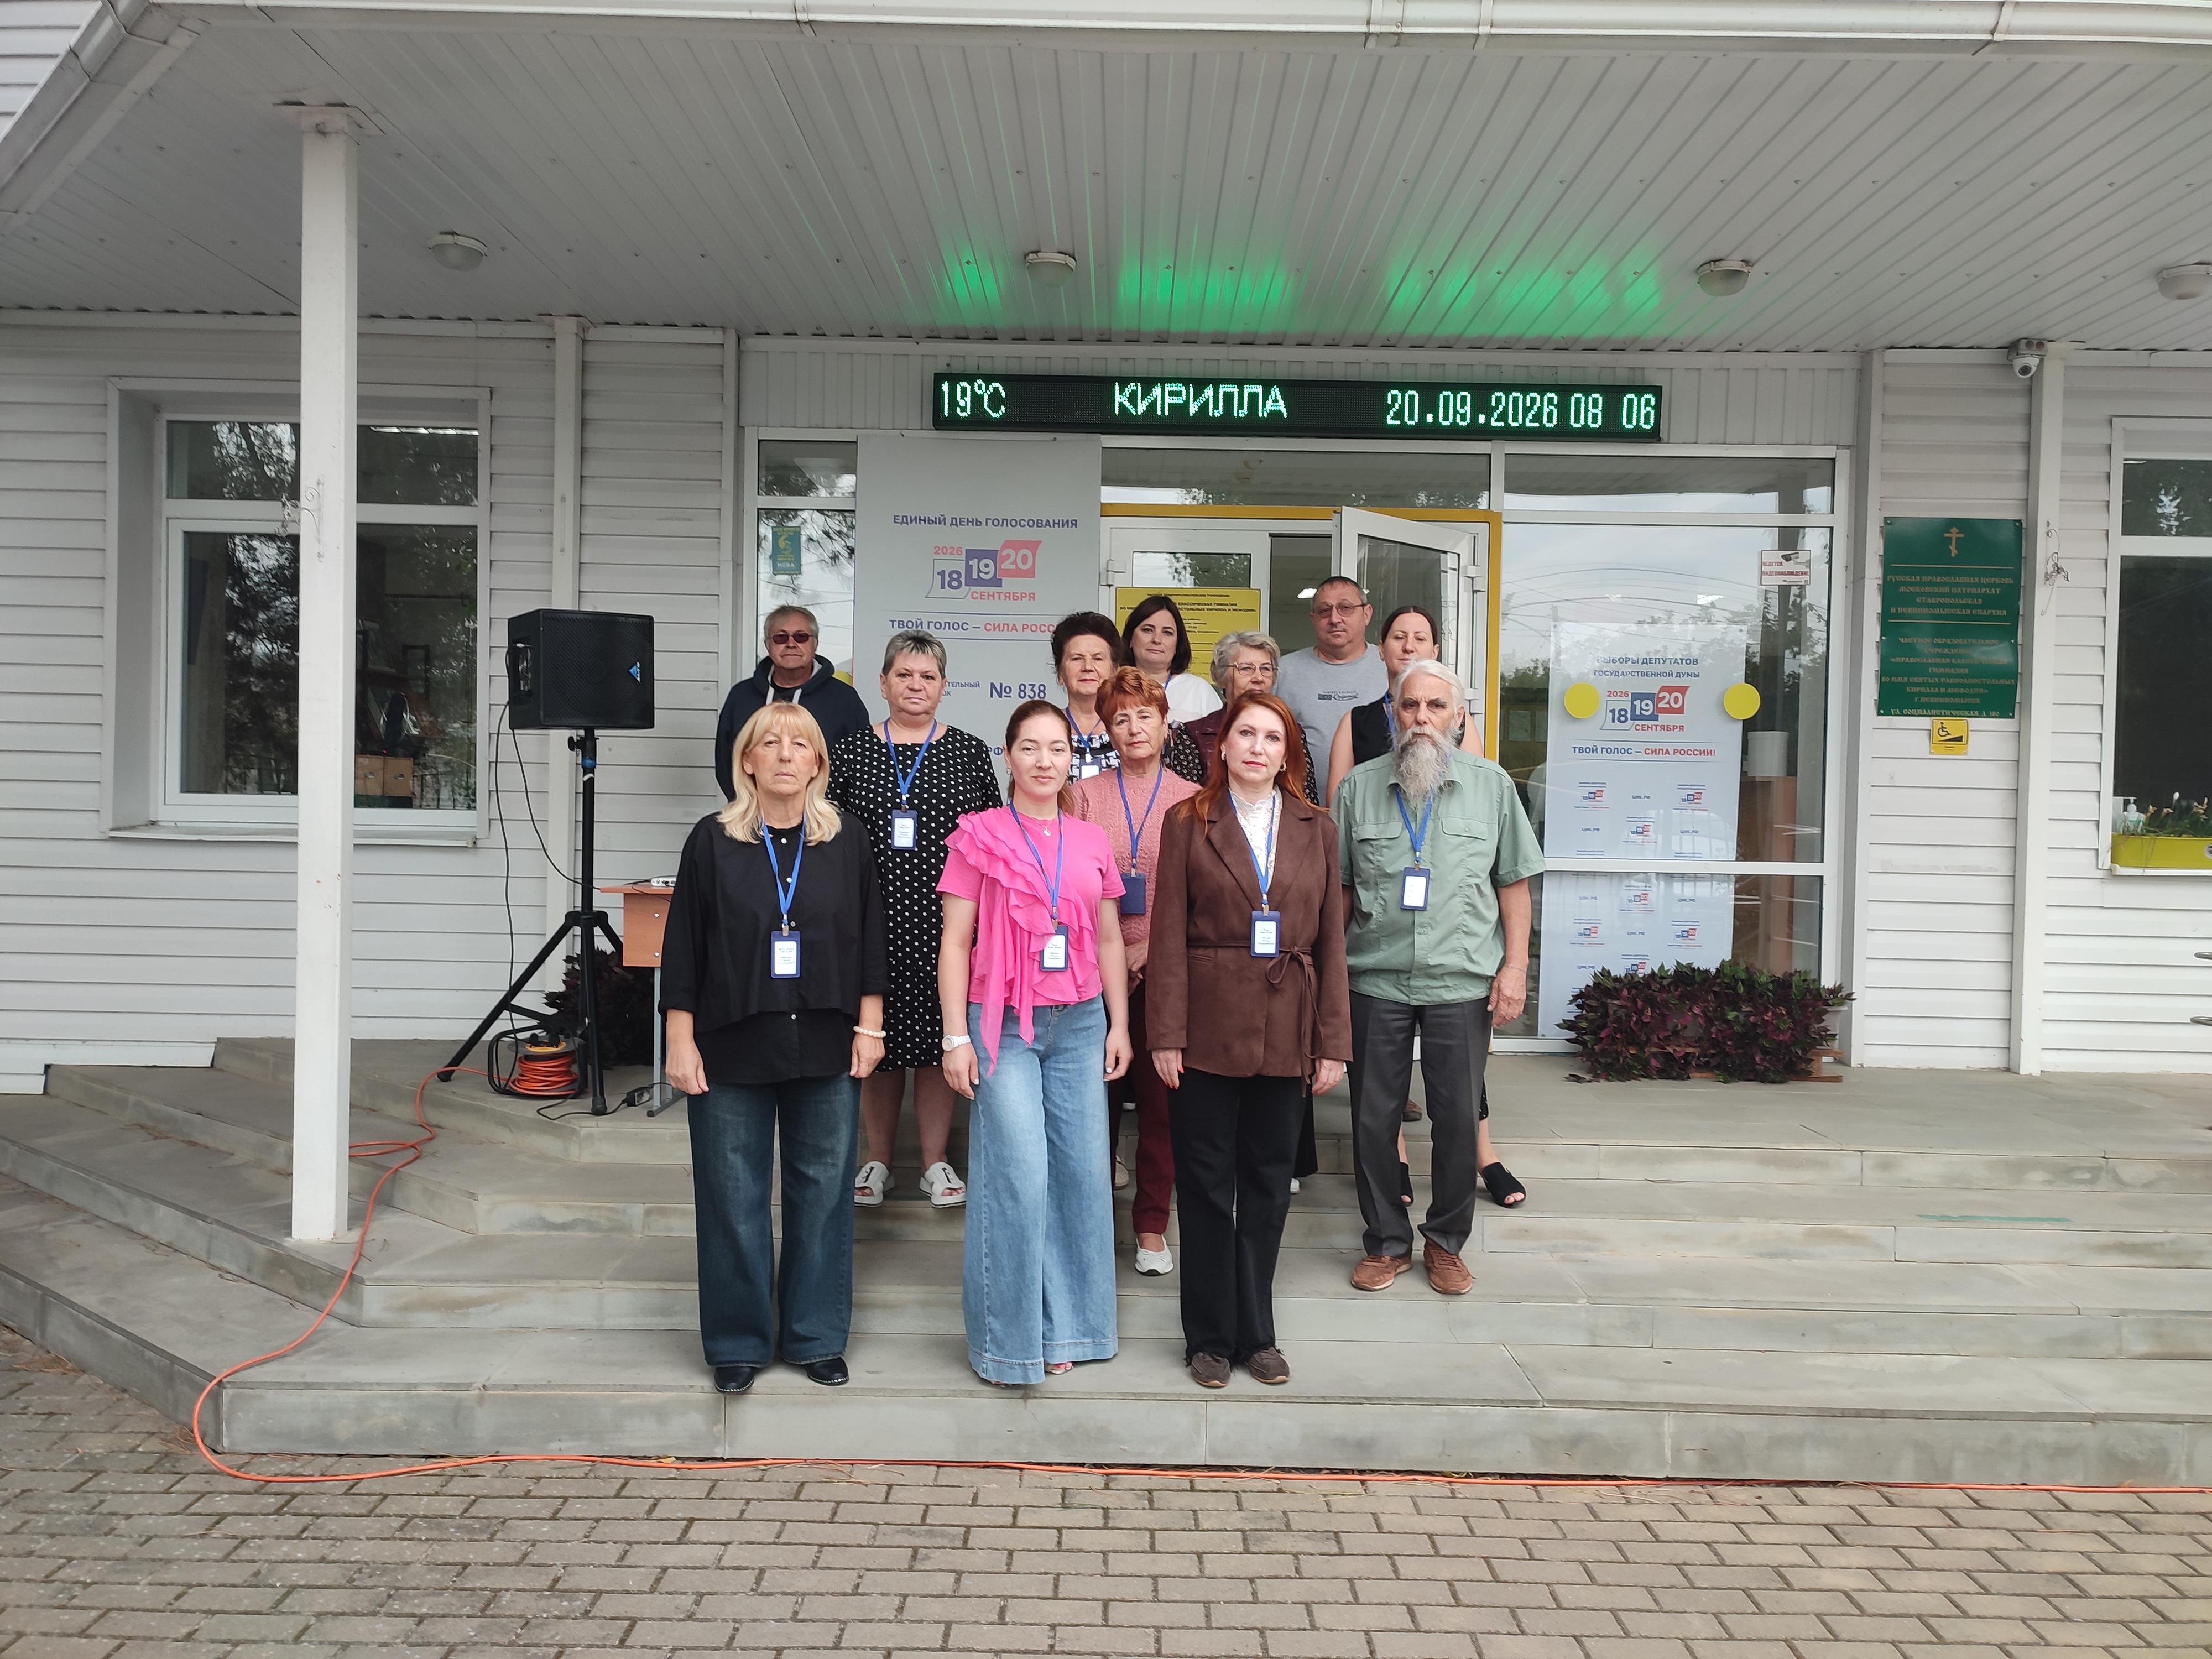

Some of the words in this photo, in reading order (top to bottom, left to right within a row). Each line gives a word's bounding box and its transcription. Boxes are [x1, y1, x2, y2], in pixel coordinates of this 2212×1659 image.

[1114, 382, 1288, 420] КИРИЛЛА
[1385, 390, 1558, 428] 20.09.2026
[1569, 392, 1603, 429] 08
[1622, 393, 1656, 430] 06
[893, 514, 947, 526] ЕДИНЫЙ
[949, 516, 983, 528] ДЕНЬ
[985, 518, 1078, 529] ГОЛОСОВАНИЯ
[933, 546, 963, 556] 2026
[1001, 549, 1033, 570] 20
[968, 558, 995, 580] 19
[937, 570, 963, 590] 18
[971, 591, 1036, 602] СЕНТЯБРЯ
[889, 618, 924, 630] ТВОЙ
[927, 621, 969, 632] ГОЛОС
[984, 622, 1018, 633] СИЛА
[1022, 623, 1055, 633] РОСС
[1597, 656, 1639, 665] ВЫБОРЫ
[1641, 657, 1699, 666] ДЕПУТАТОВ
[1594, 669, 1673, 679] ГОСУДАРСТВЕННОЙ
[1675, 670, 1700, 679] ДУМЫ
[989, 682, 1013, 699] №
[1018, 683, 1047, 700] 838
[1633, 699, 1653, 716] 19
[1658, 692, 1683, 708] 20
[1609, 708, 1629, 724] 18
[1634, 724, 1685, 732] СЕНТЯБРЯ
[1572, 744, 1598, 754] ТВОЙ
[1600, 747, 1633, 755] ГОЛОС
[1673, 749, 1716, 757] РОССИИ!
